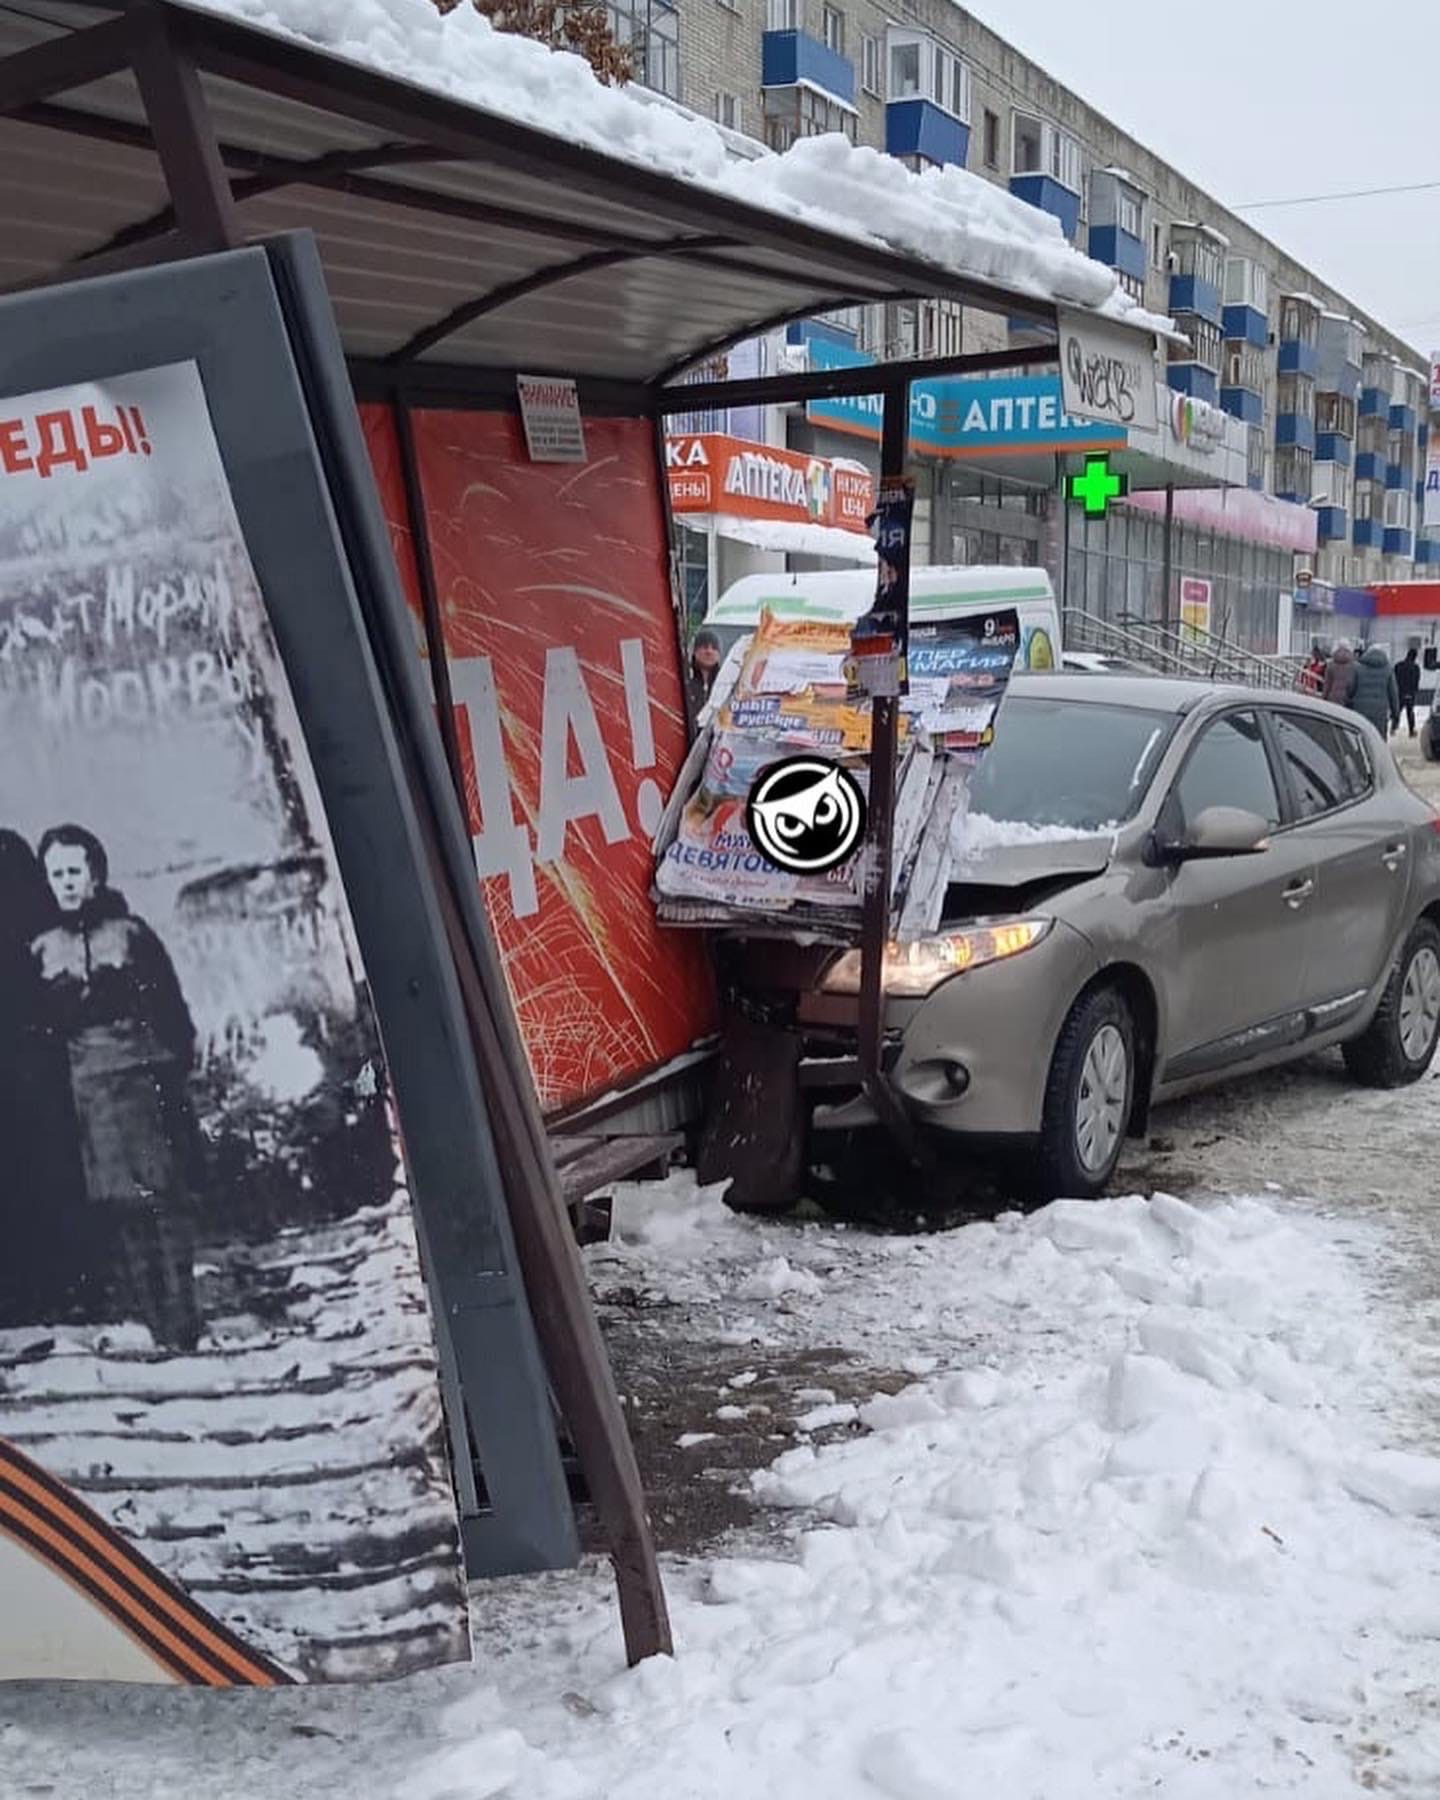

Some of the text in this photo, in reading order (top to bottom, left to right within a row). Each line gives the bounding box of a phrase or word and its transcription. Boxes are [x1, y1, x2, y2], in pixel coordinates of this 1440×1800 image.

[671, 480, 706, 498] ЕНЫ
[725, 453, 808, 508] АПТЕКА
[983, 618, 996, 637] 9
[913, 654, 1011, 673] МАГИЯ
